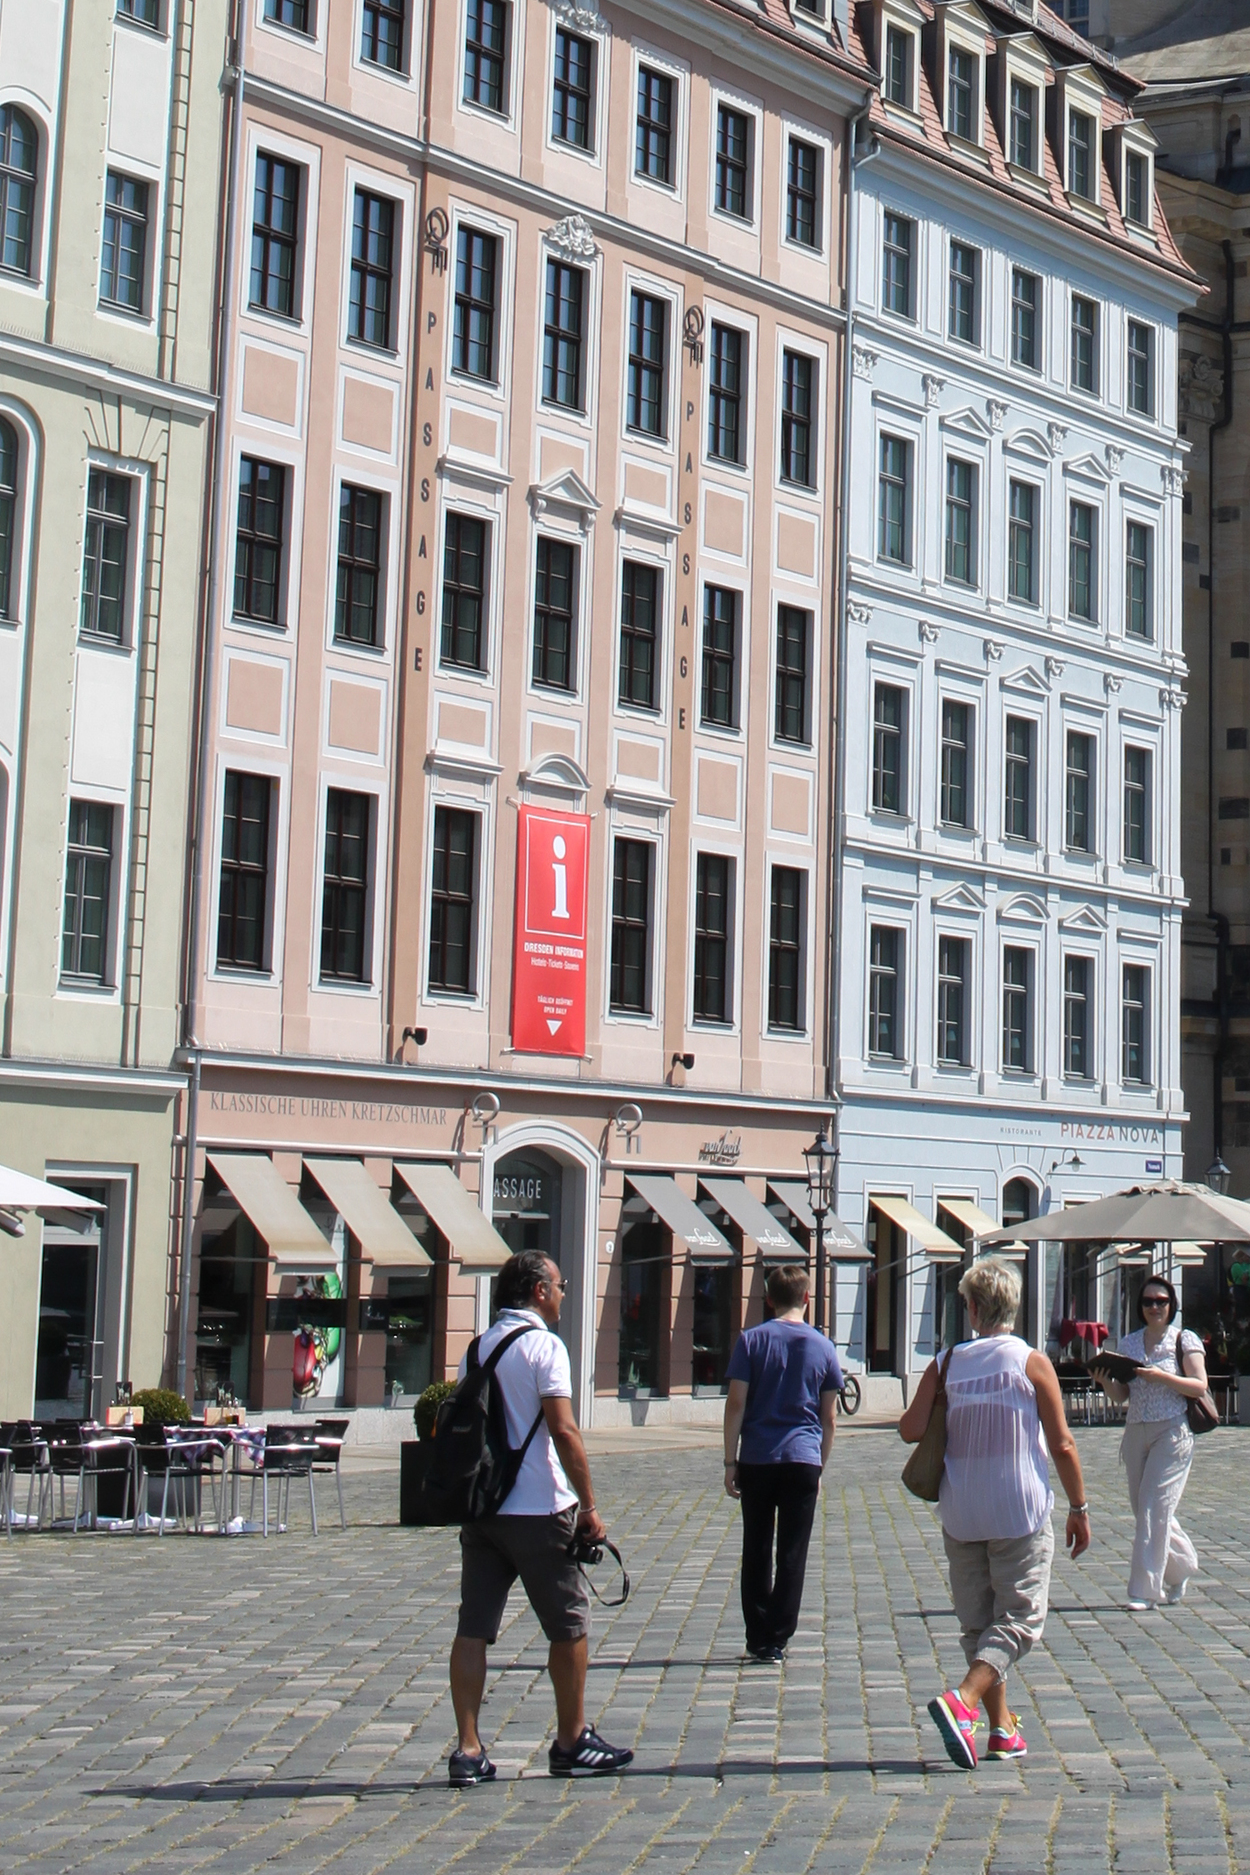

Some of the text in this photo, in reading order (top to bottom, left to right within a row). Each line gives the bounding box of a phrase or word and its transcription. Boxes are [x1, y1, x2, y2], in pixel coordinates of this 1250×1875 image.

[414, 311, 437, 672] PASSAGE
[678, 400, 695, 731] PASSAGE
[524, 941, 554, 955] DRESDEN
[210, 1091, 447, 1125] KLASSISCHE UHREN KRETZSCHMAR
[1000, 1122, 1159, 1144] RISTORANTE PIAZZA NOVA
[493, 1177, 542, 1199] ASSAGE
